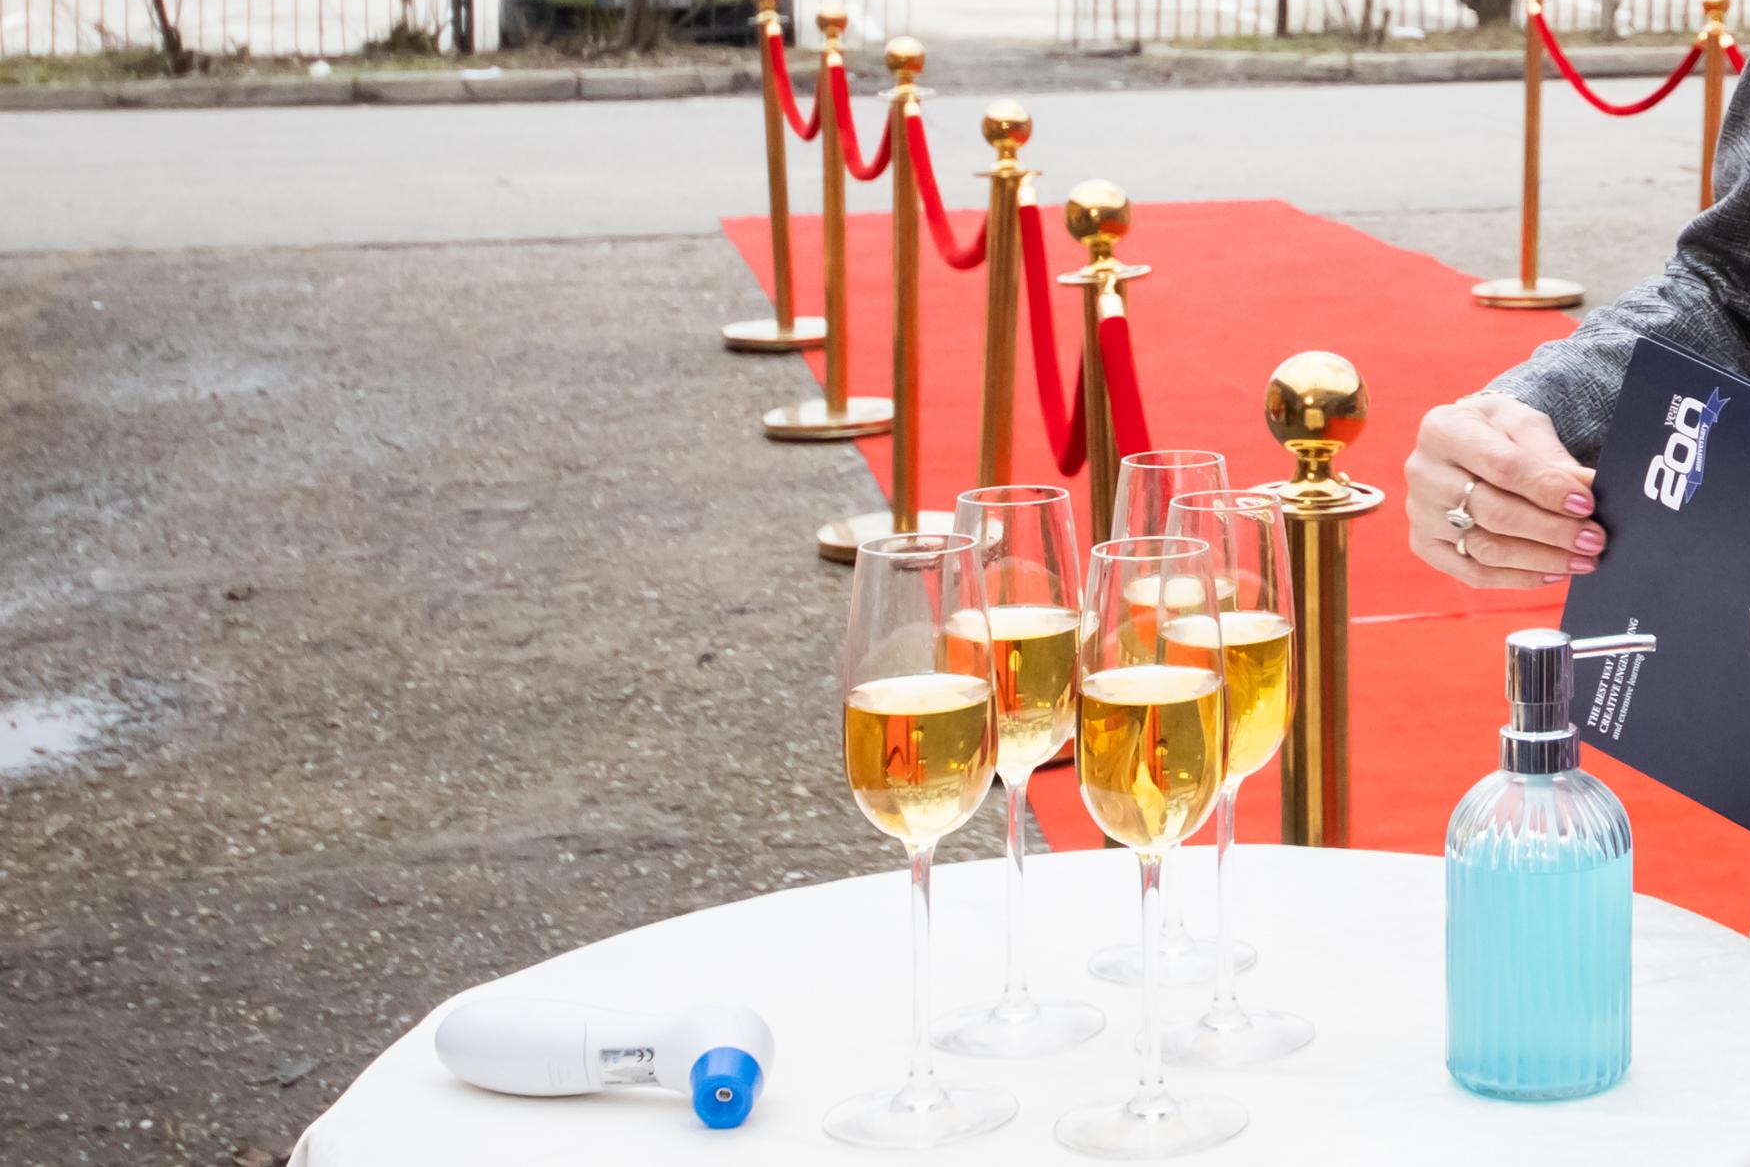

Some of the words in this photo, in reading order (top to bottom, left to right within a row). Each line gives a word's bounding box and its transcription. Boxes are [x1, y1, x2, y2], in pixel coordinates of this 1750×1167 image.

[1664, 394, 1683, 428] years
[1644, 397, 1707, 511] 200
[1695, 422, 1710, 472] anniversary
[1587, 705, 1601, 726] THE
[1594, 680, 1608, 705] BEST
[1601, 658, 1615, 680] WAY
[1600, 684, 1621, 733] CREATIVE
[1612, 722, 1623, 740] and
[1618, 686, 1634, 723] extensive
[1627, 653, 1645, 687] learning
